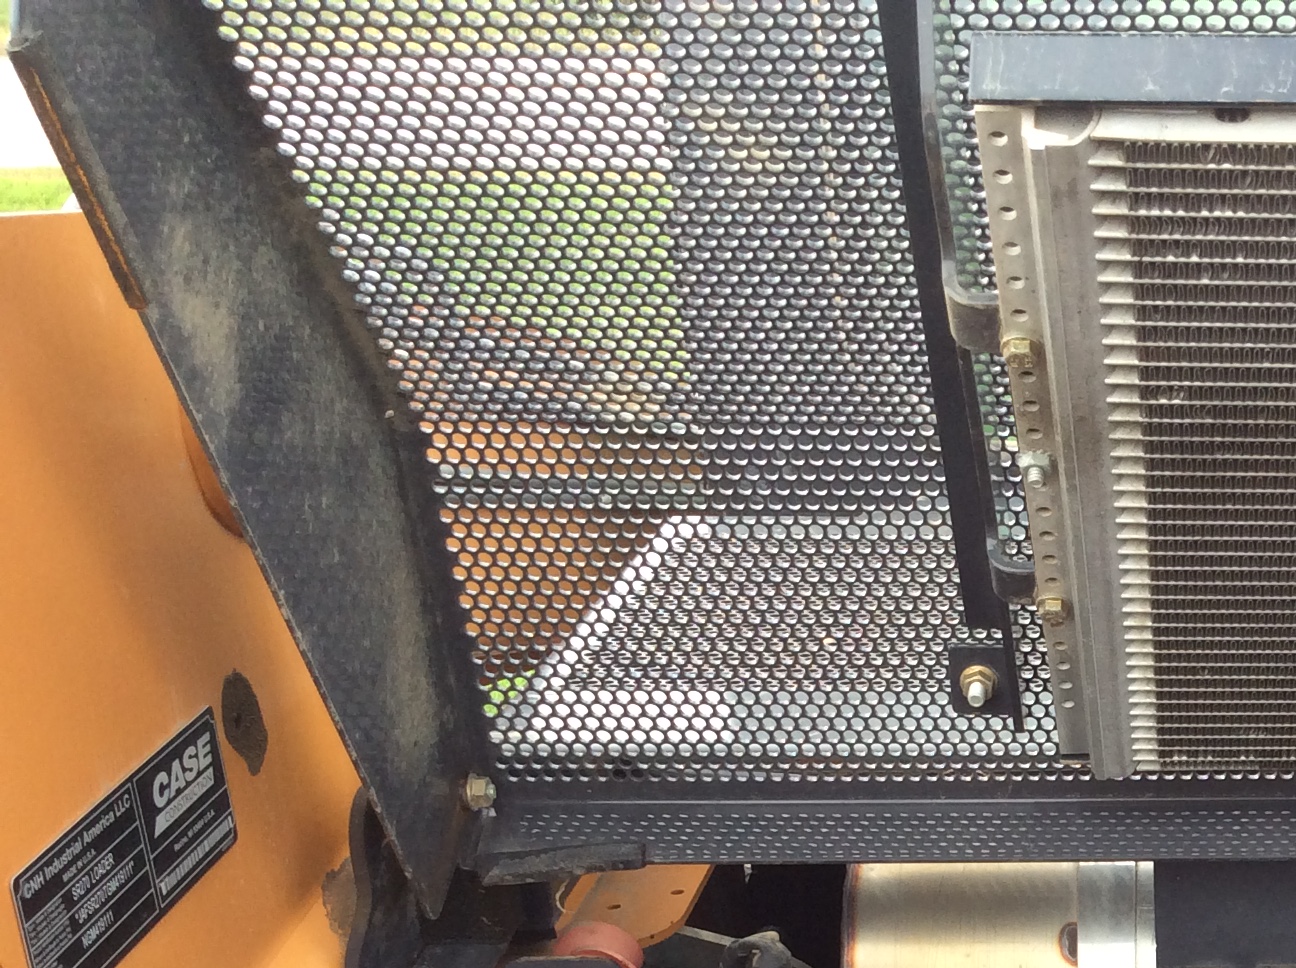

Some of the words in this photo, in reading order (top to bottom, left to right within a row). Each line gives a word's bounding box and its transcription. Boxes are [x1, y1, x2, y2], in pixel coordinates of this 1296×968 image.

[153, 731, 213, 808] CASE
[164, 771, 213, 822] CONSTRUCTION
[23, 871, 45, 898] CNH
[44, 836, 83, 880] Industrial
[83, 811, 115, 846] America
[114, 794, 131, 817] LLC
[62, 864, 77, 882] MADE
[71, 875, 91, 900] SR270
[90, 852, 115, 883] LOADER
